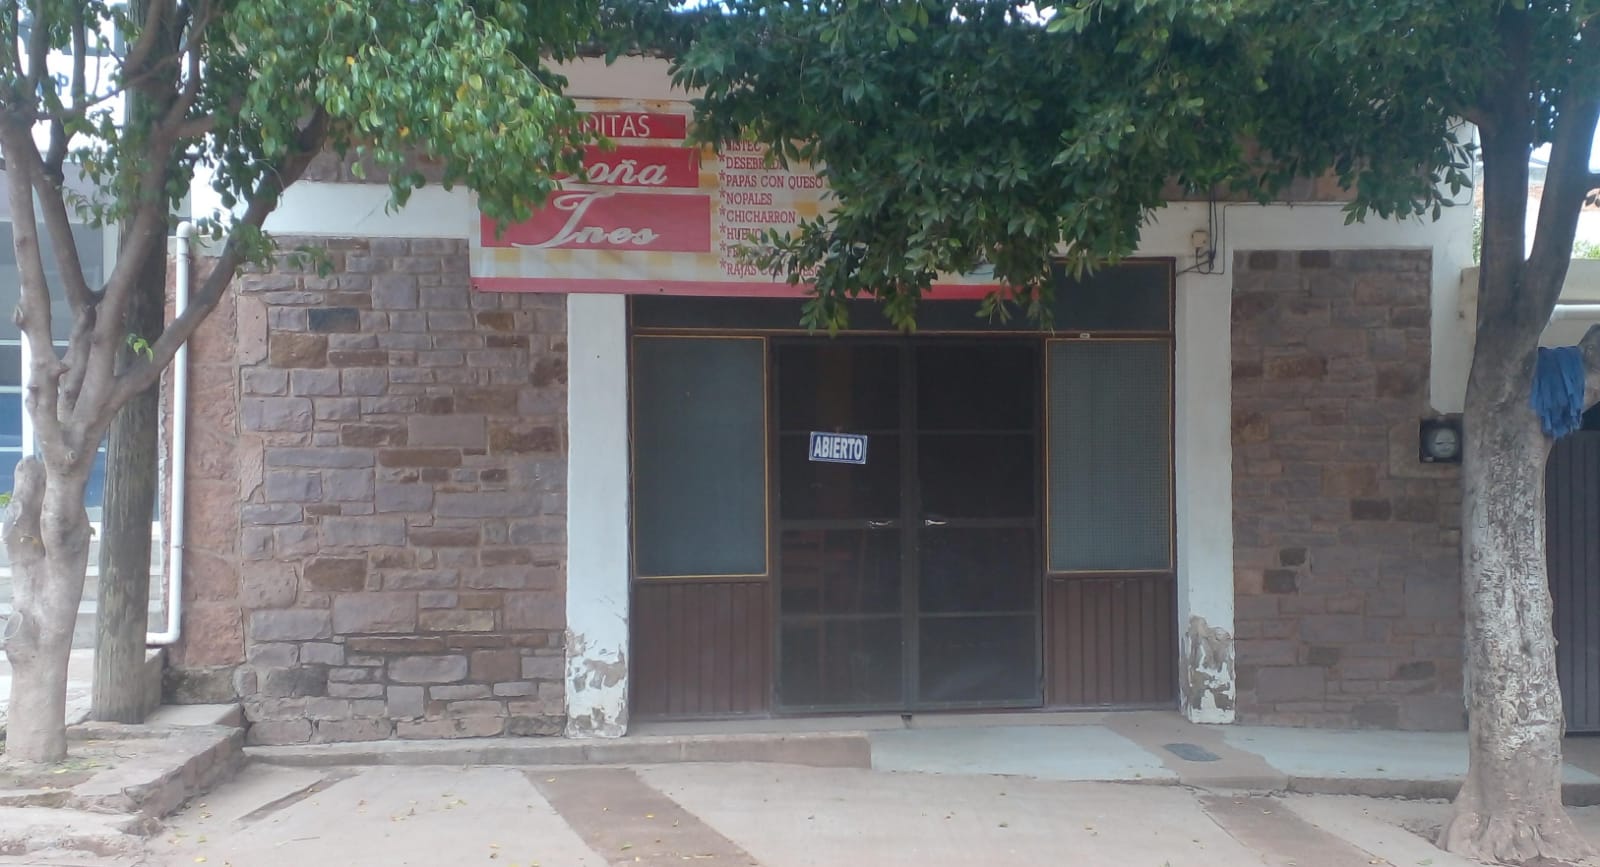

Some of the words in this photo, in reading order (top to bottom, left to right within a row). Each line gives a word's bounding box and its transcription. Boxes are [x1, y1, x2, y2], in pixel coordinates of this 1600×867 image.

[726, 175, 757, 188] PAPAS
[760, 175, 784, 187] CON
[788, 175, 823, 189] QUESO
[727, 193, 772, 205] NOPALES
[726, 210, 796, 223] CHICHARRON
[727, 263, 757, 278] RAJAS
[813, 435, 863, 461] ABIERTO
